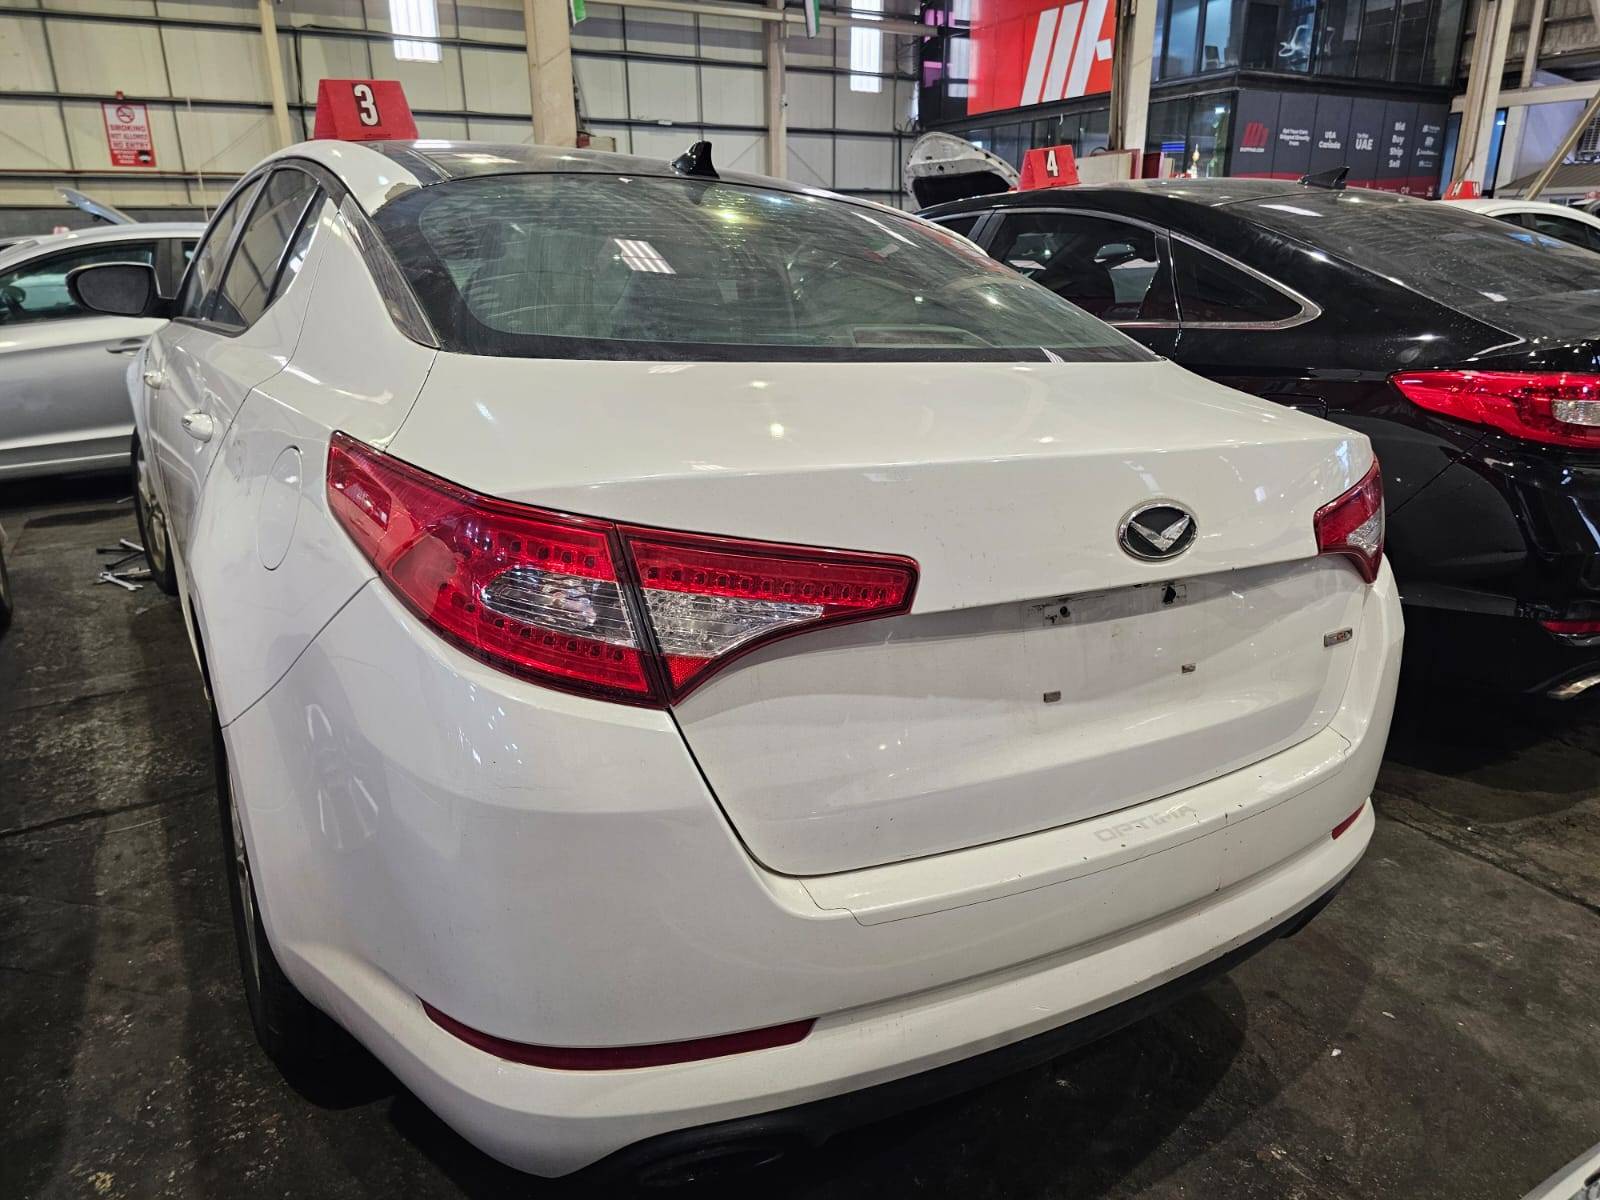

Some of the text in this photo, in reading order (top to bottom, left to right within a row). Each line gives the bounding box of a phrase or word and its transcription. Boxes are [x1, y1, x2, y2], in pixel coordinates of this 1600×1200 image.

[353, 84, 378, 126] 3
[1395, 122, 1406, 131] Bid
[1355, 139, 1374, 150] UAE
[1392, 135, 1405, 145] Buy
[1389, 147, 1404, 158] Ship
[1047, 150, 1059, 177] 4
[1389, 160, 1400, 168] Sell
[1094, 804, 1195, 841] OPTIMA
